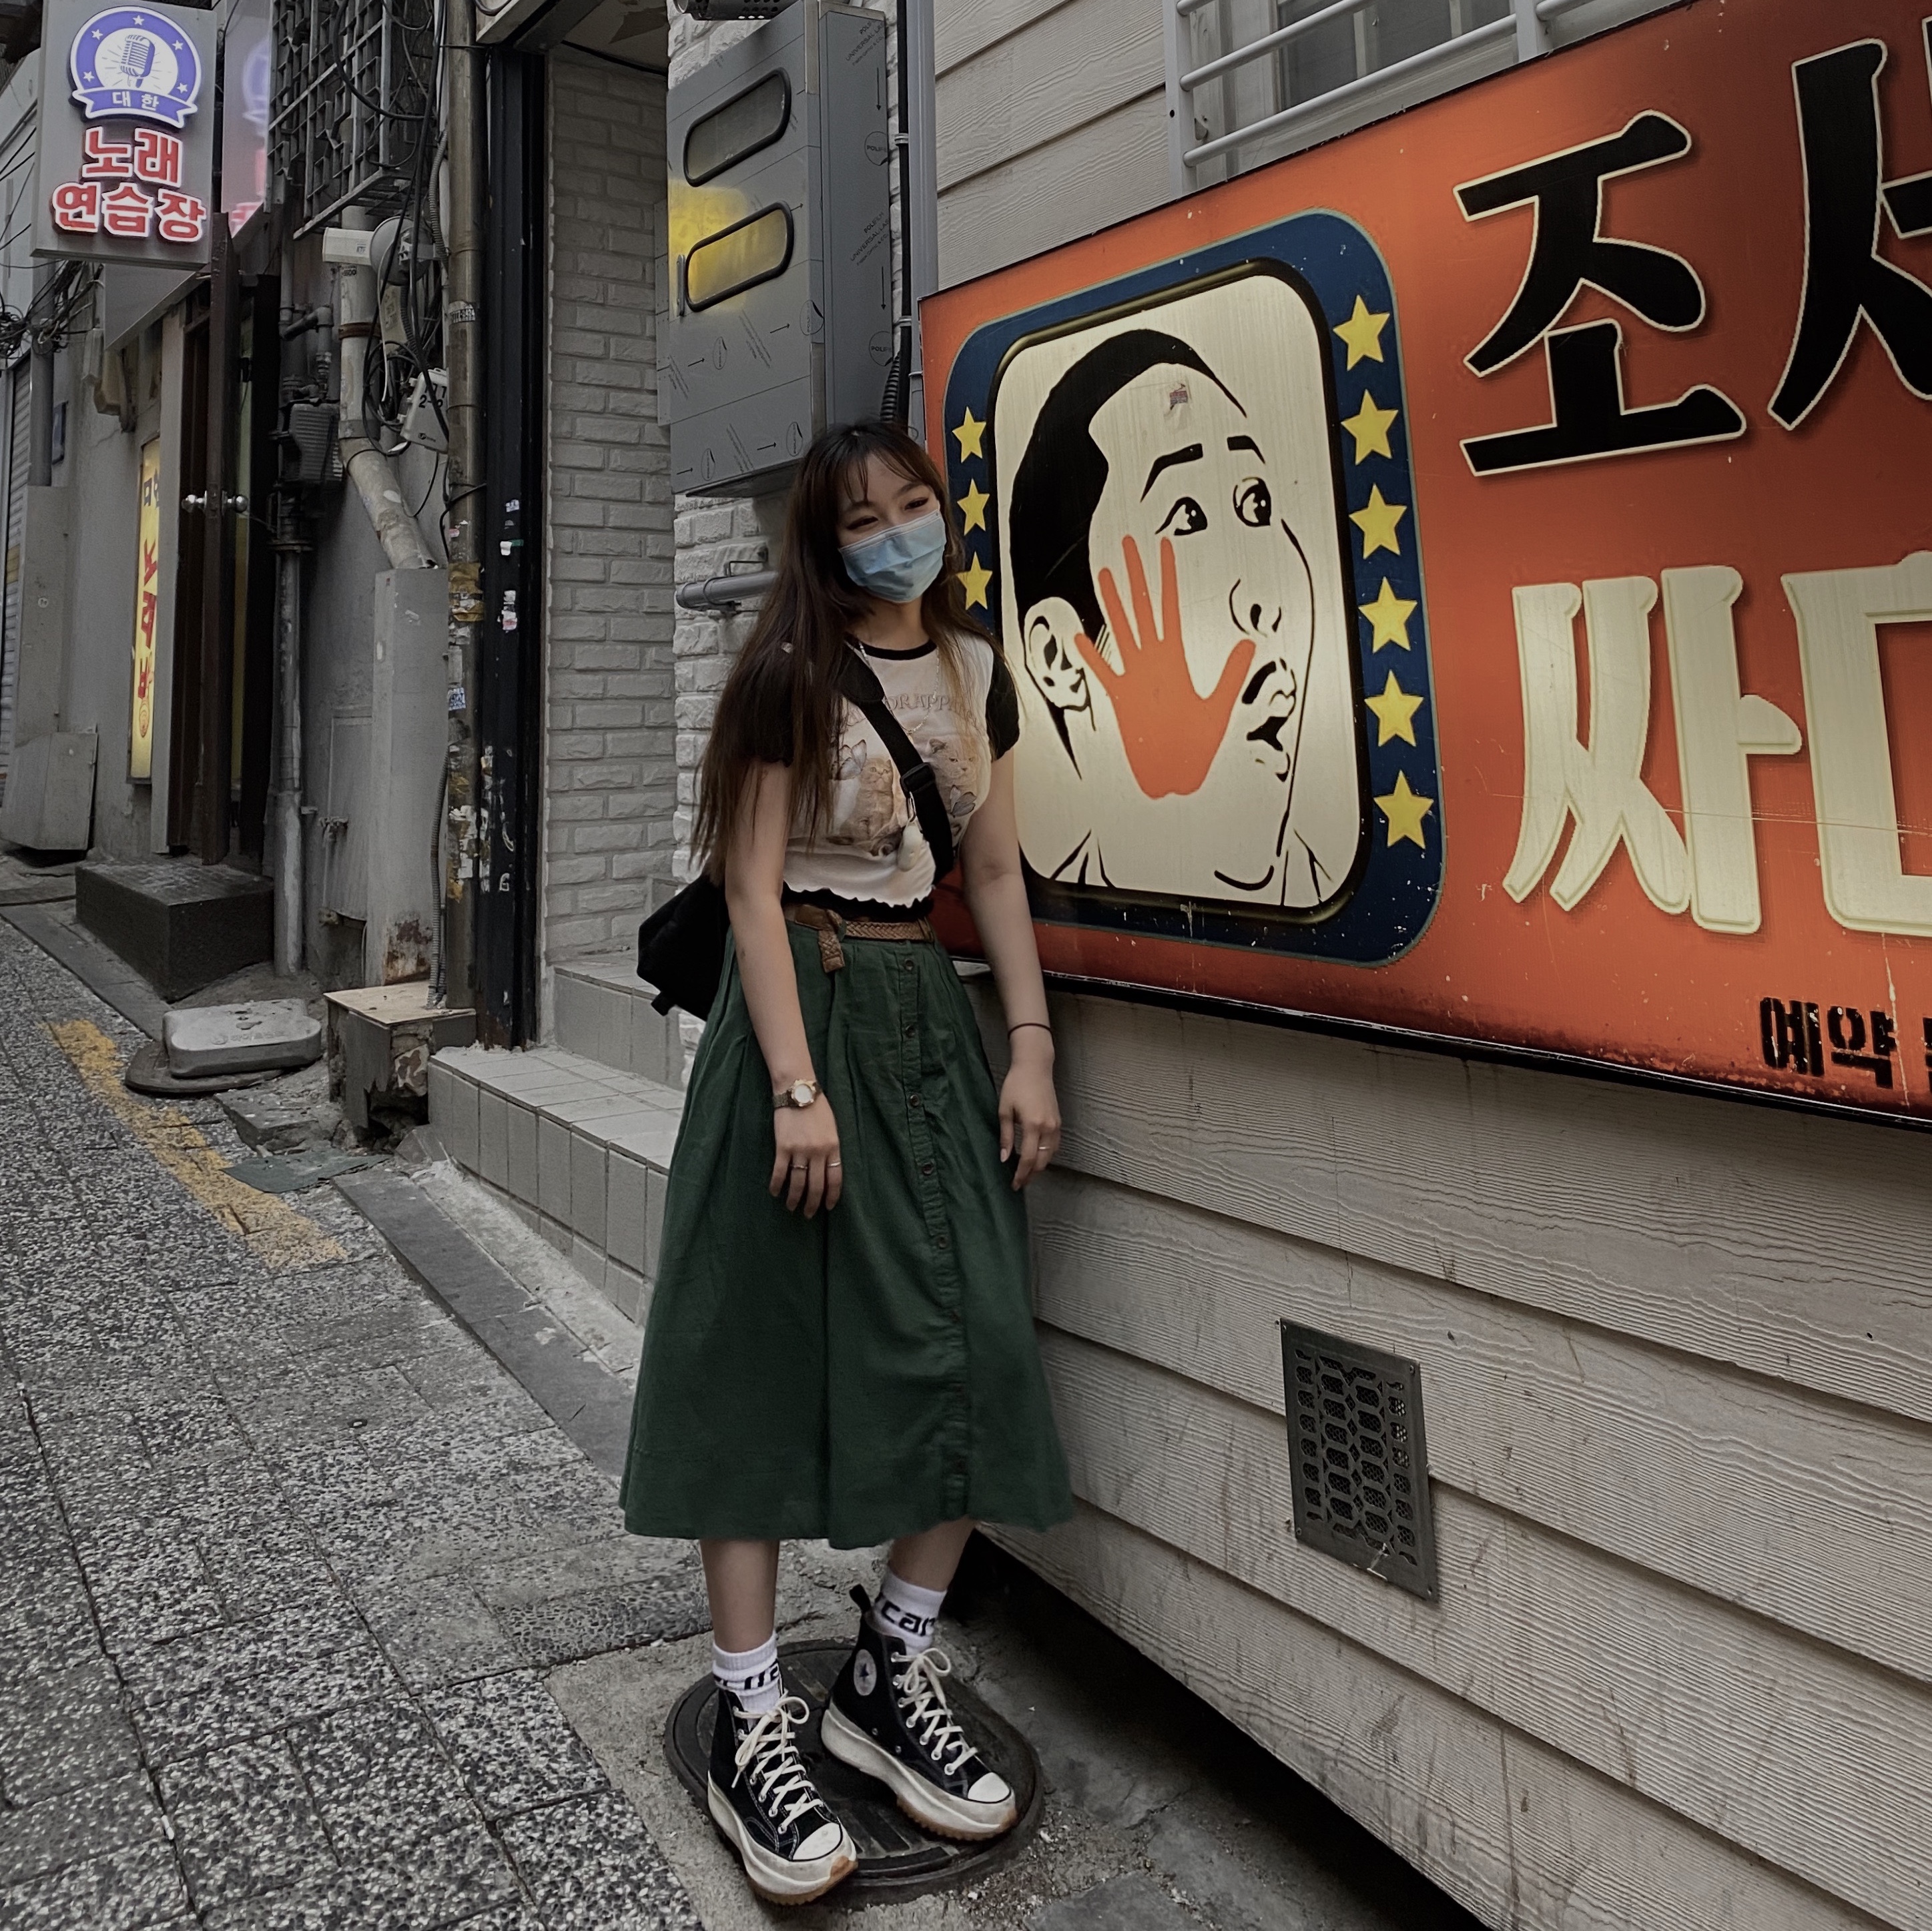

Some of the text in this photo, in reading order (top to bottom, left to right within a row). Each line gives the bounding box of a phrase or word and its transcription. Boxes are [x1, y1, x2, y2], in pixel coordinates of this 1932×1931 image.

[82, 126, 183, 188] 노래
[52, 181, 207, 242] 연습장
[850, 230, 880, 261] UNIVERSAL
[1760, 997, 1895, 1090] 예약
